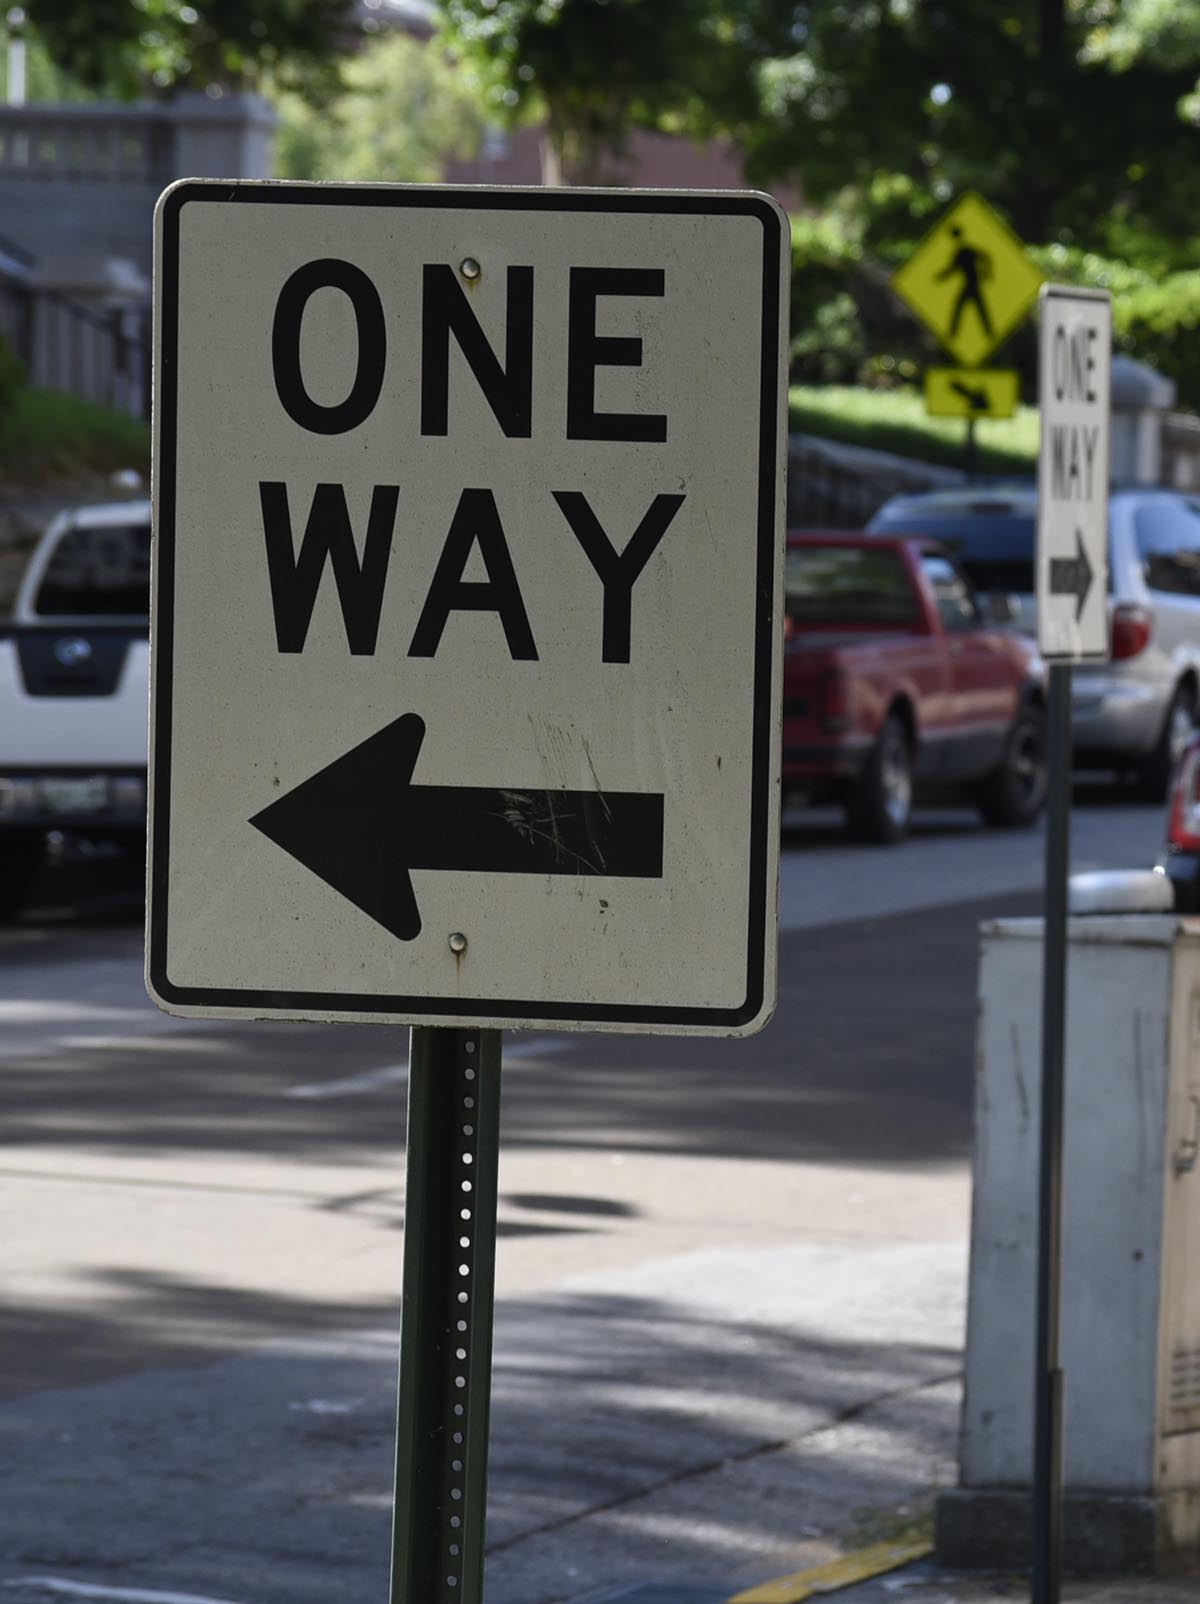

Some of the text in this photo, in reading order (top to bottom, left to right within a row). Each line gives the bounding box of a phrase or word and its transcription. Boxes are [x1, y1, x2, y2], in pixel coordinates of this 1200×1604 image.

[271, 257, 668, 443] ONE
[1053, 325, 1098, 404] ONE
[1052, 424, 1099, 500] WAY
[258, 481, 687, 665] WAY
